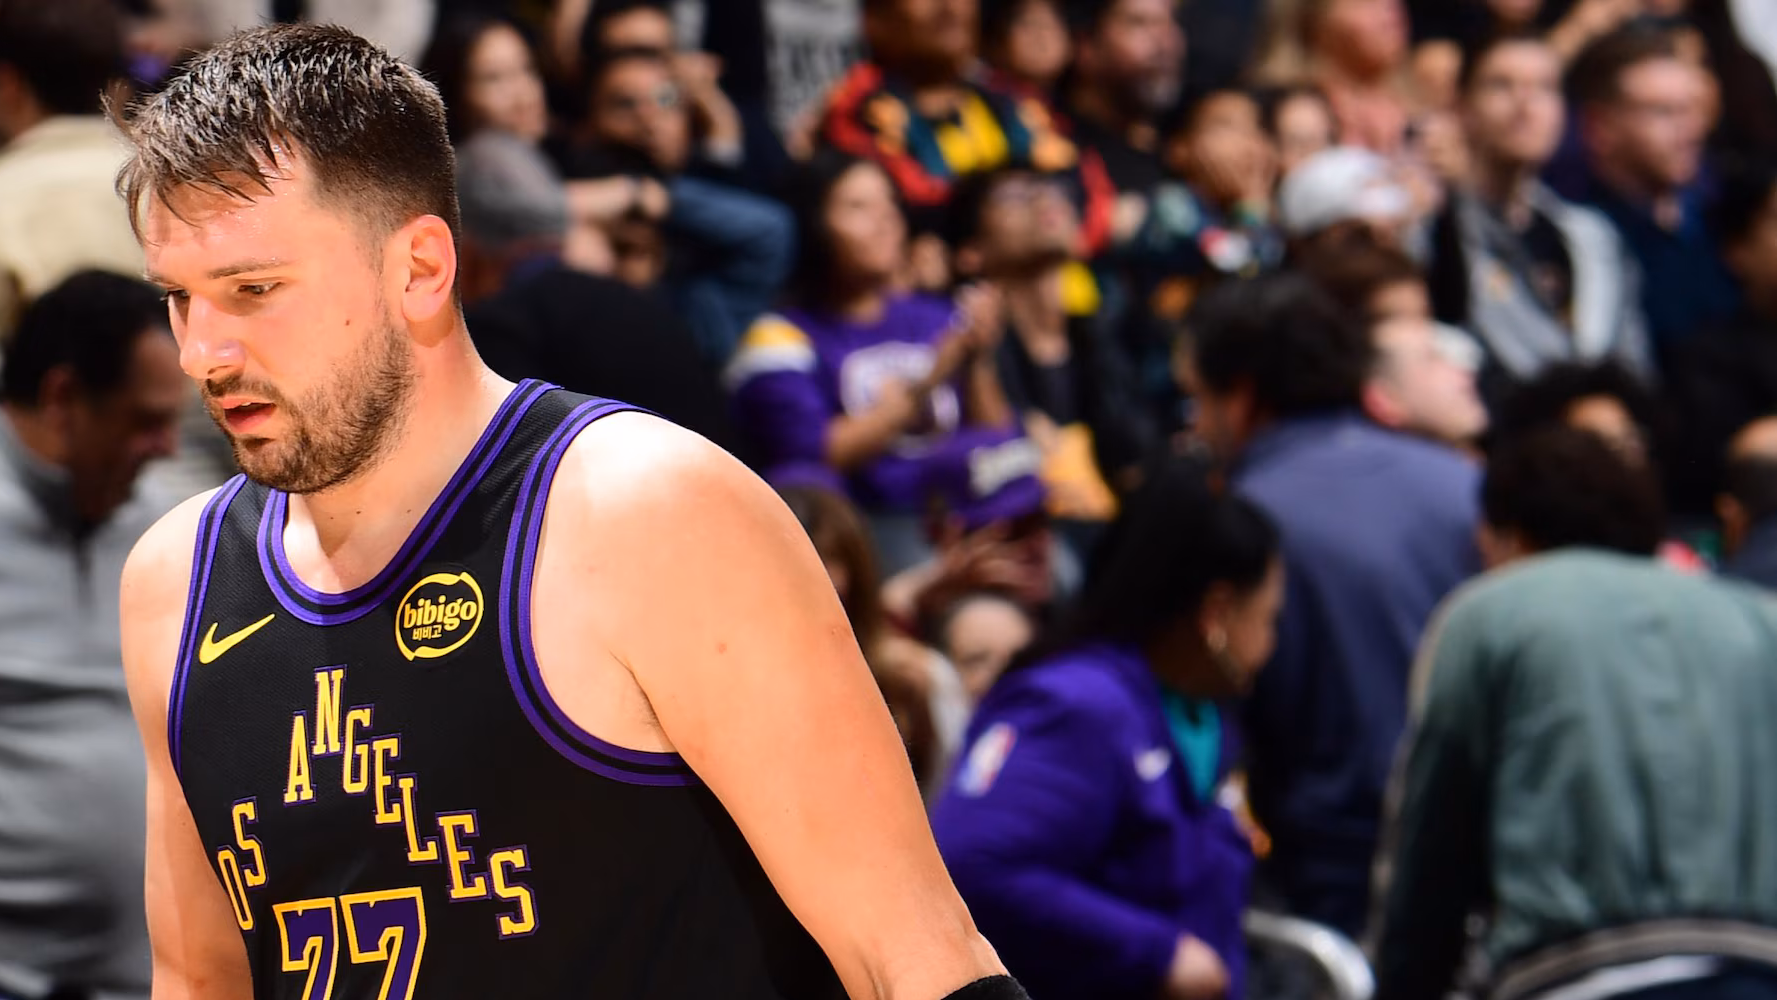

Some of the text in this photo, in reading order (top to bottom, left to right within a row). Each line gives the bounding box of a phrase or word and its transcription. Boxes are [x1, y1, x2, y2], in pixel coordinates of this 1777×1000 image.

[403, 594, 478, 631] bibigo
[412, 624, 443, 641] 비비고
[217, 664, 539, 940] OS ANGELES
